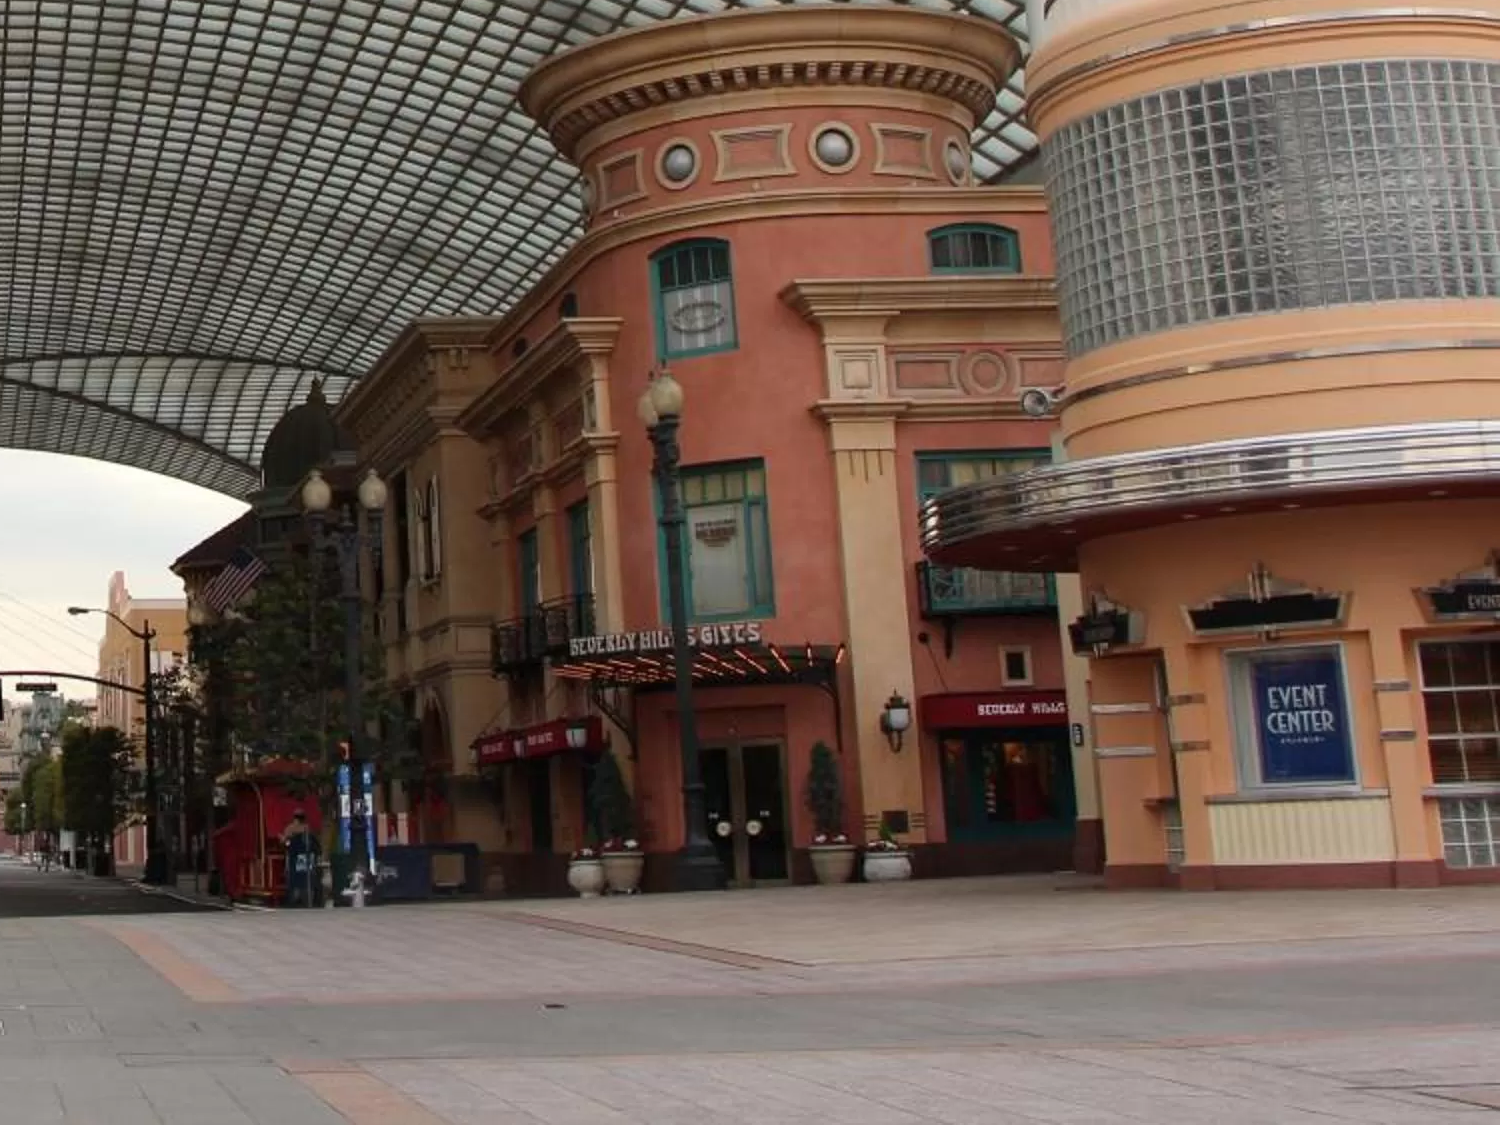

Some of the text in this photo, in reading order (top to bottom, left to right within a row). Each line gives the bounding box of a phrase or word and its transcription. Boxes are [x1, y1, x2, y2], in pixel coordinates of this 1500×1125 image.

[569, 632, 636, 656] BEVERLY
[639, 628, 697, 651] HILS
[1266, 683, 1328, 710] EVENT
[1266, 710, 1337, 735] CENTER
